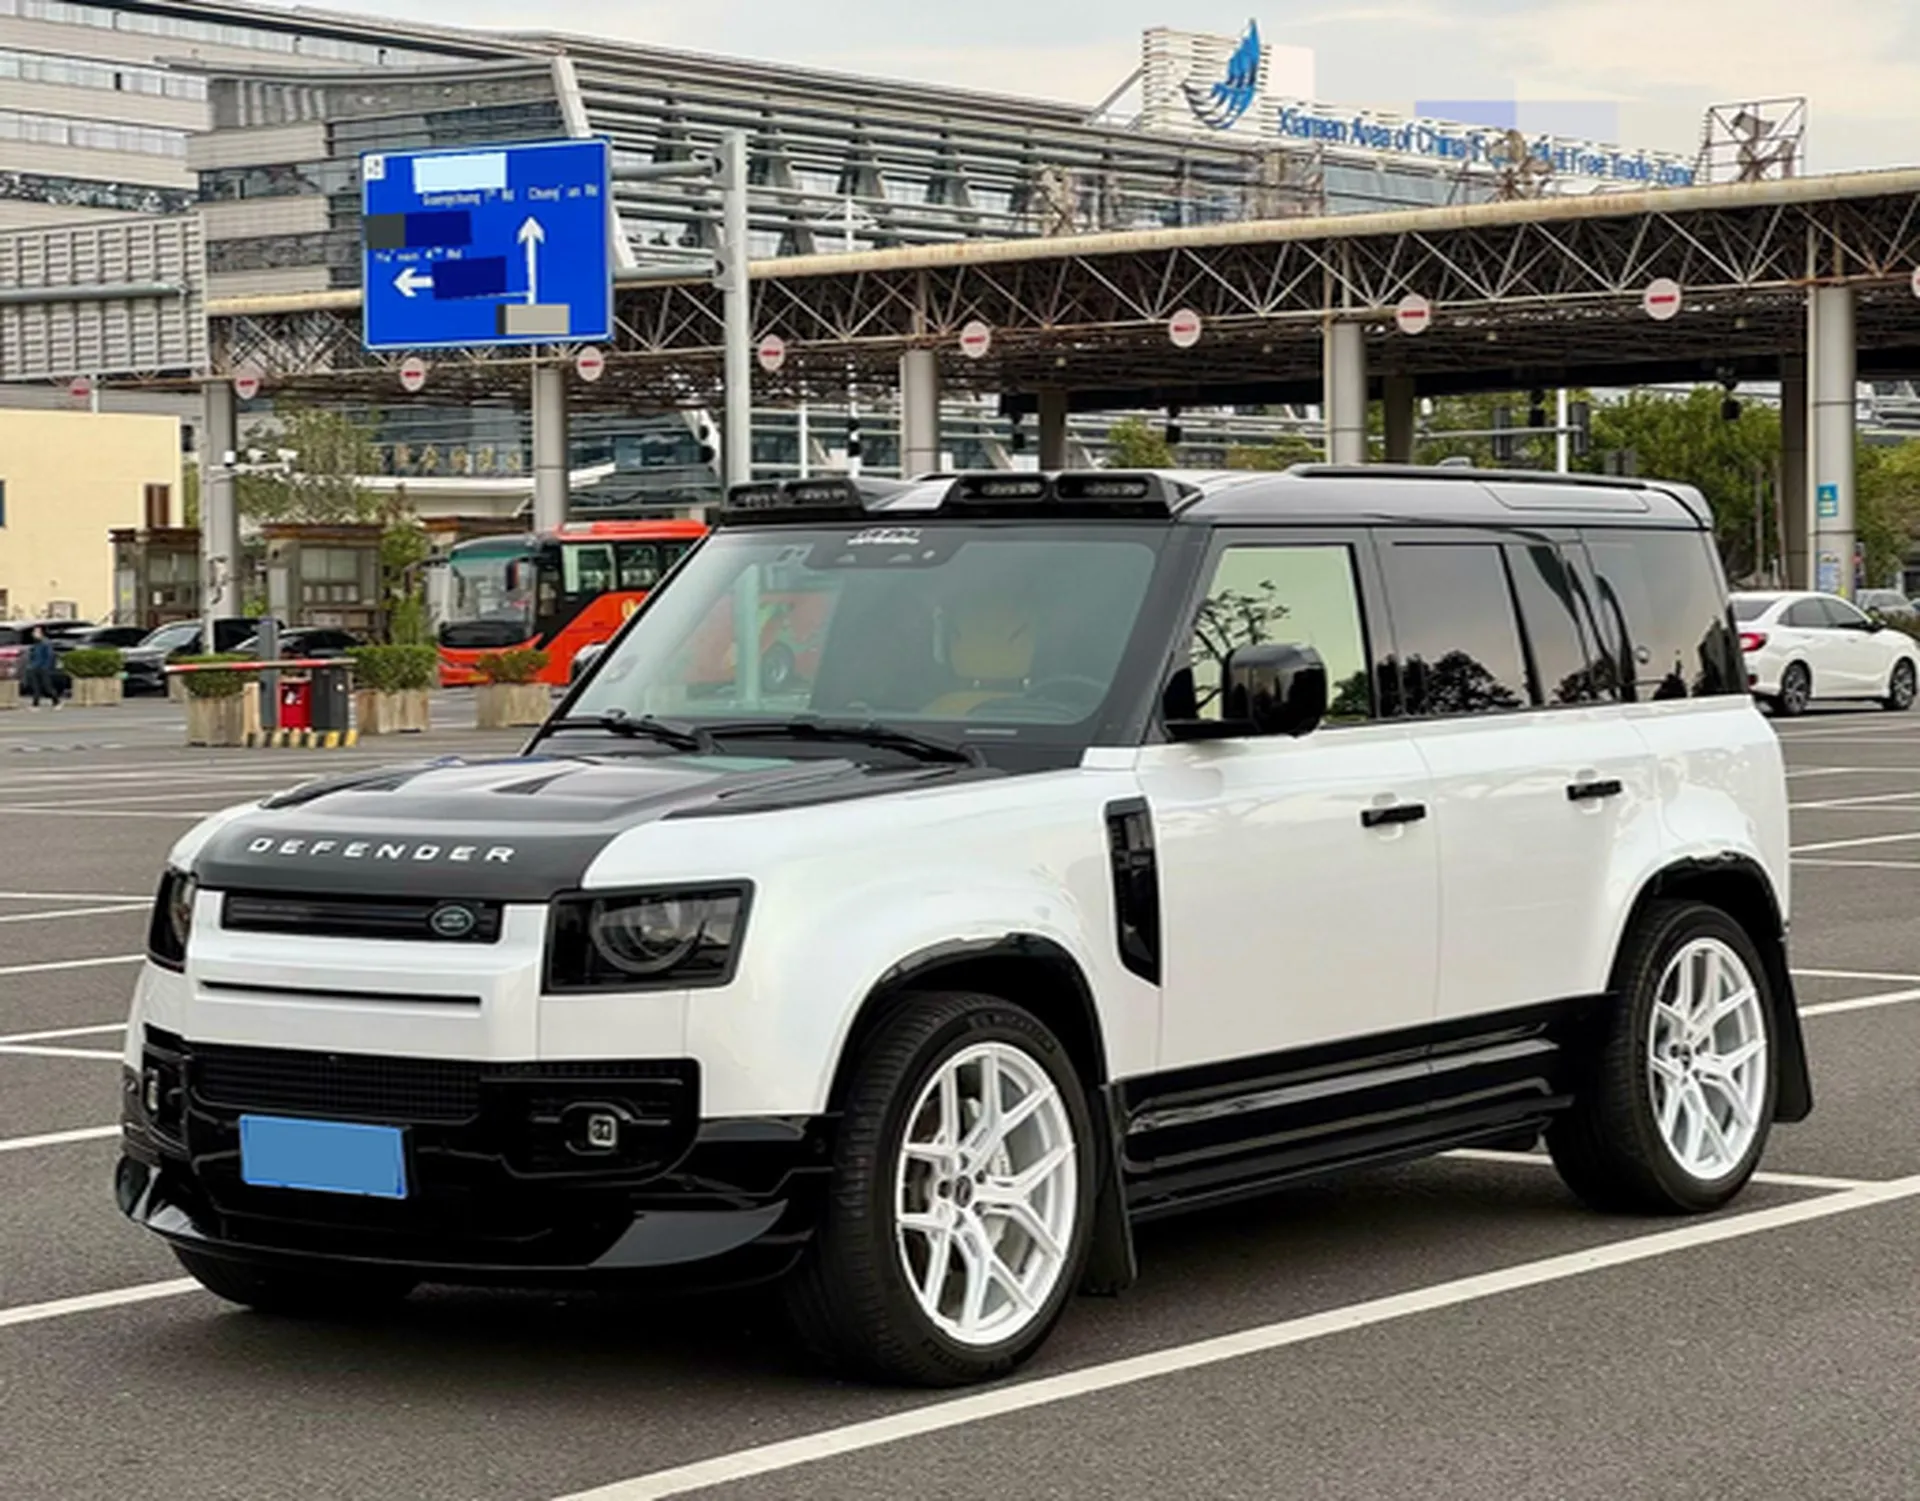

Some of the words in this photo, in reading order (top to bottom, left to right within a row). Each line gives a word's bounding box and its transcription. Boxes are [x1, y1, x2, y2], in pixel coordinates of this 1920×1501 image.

[1277, 106, 1347, 141] Xiamen
[1352, 118, 1391, 148] Area
[1395, 122, 1414, 151] of
[1416, 125, 1467, 159] China
[248, 837, 516, 864] DEFENDER
